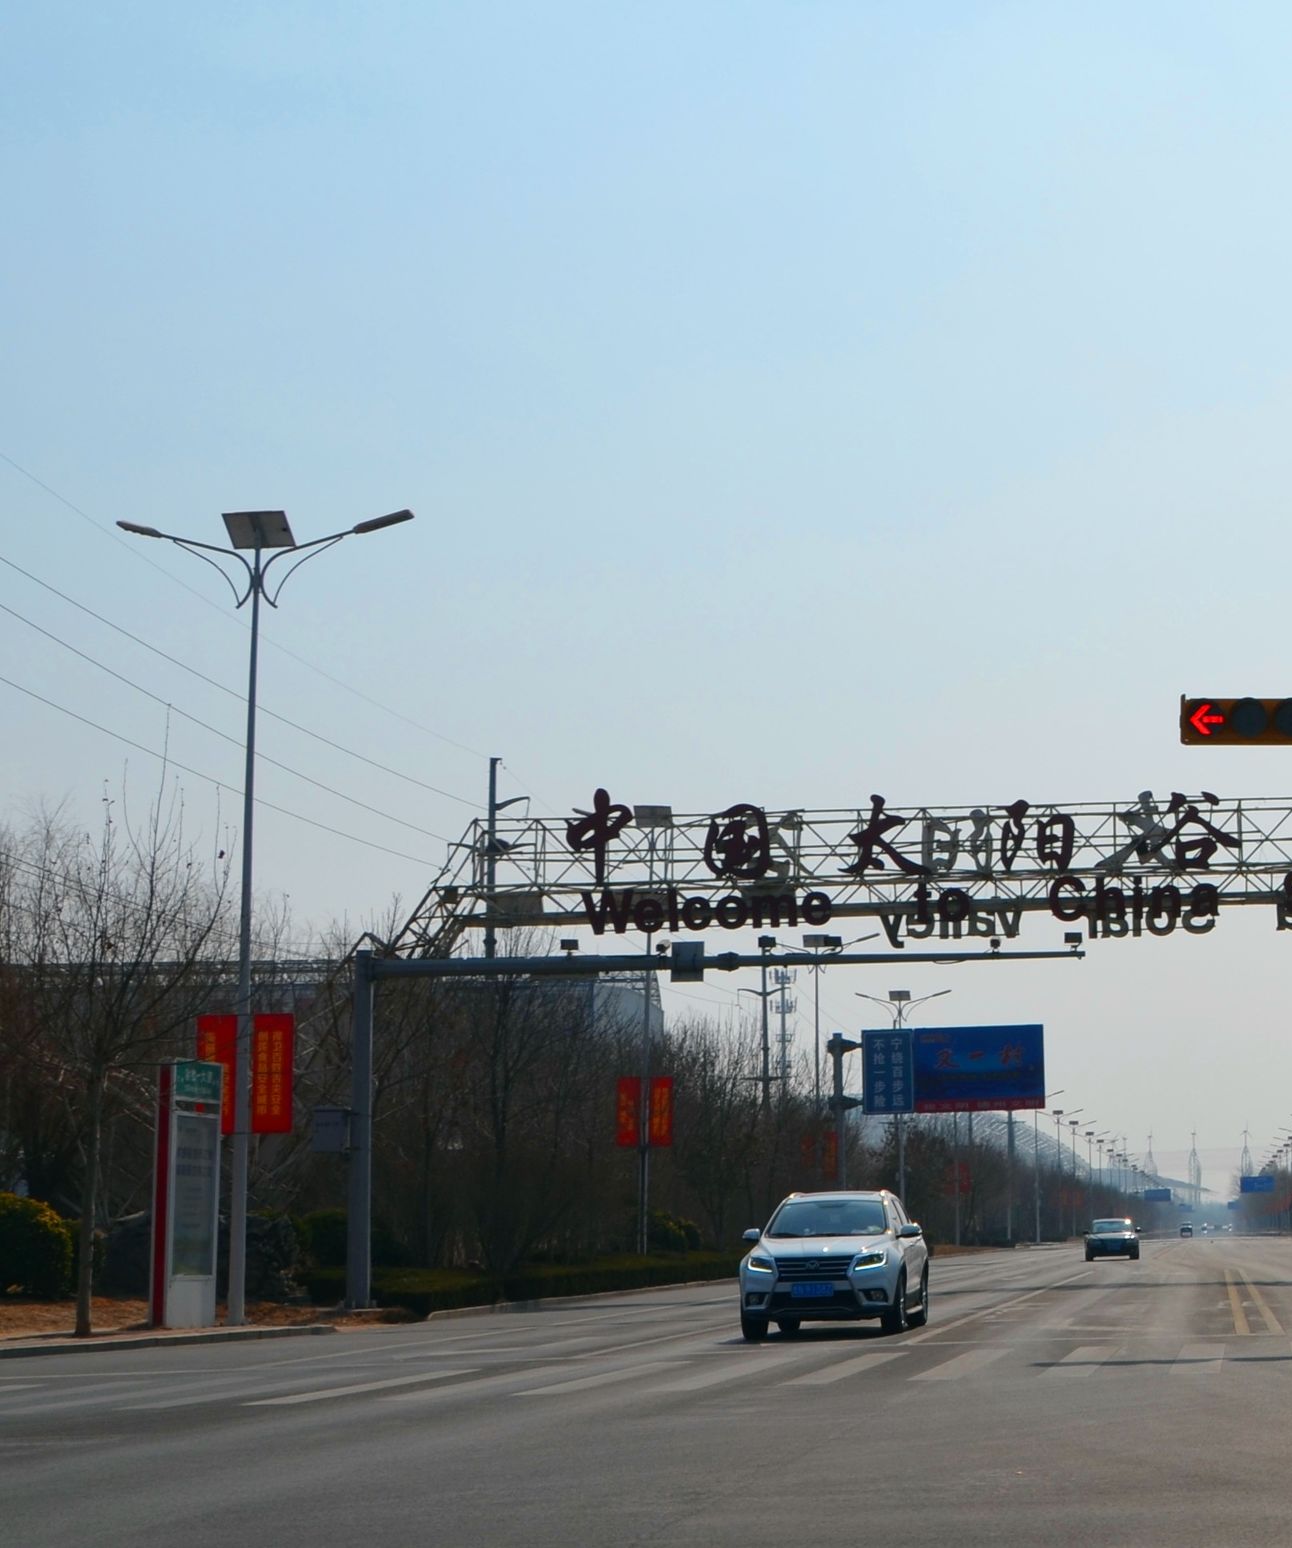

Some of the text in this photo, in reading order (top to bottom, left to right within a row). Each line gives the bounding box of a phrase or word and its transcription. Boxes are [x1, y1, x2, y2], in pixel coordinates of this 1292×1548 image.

[581, 888, 832, 935] Welcome
[914, 875, 971, 924] to
[1050, 876, 1219, 922] China
